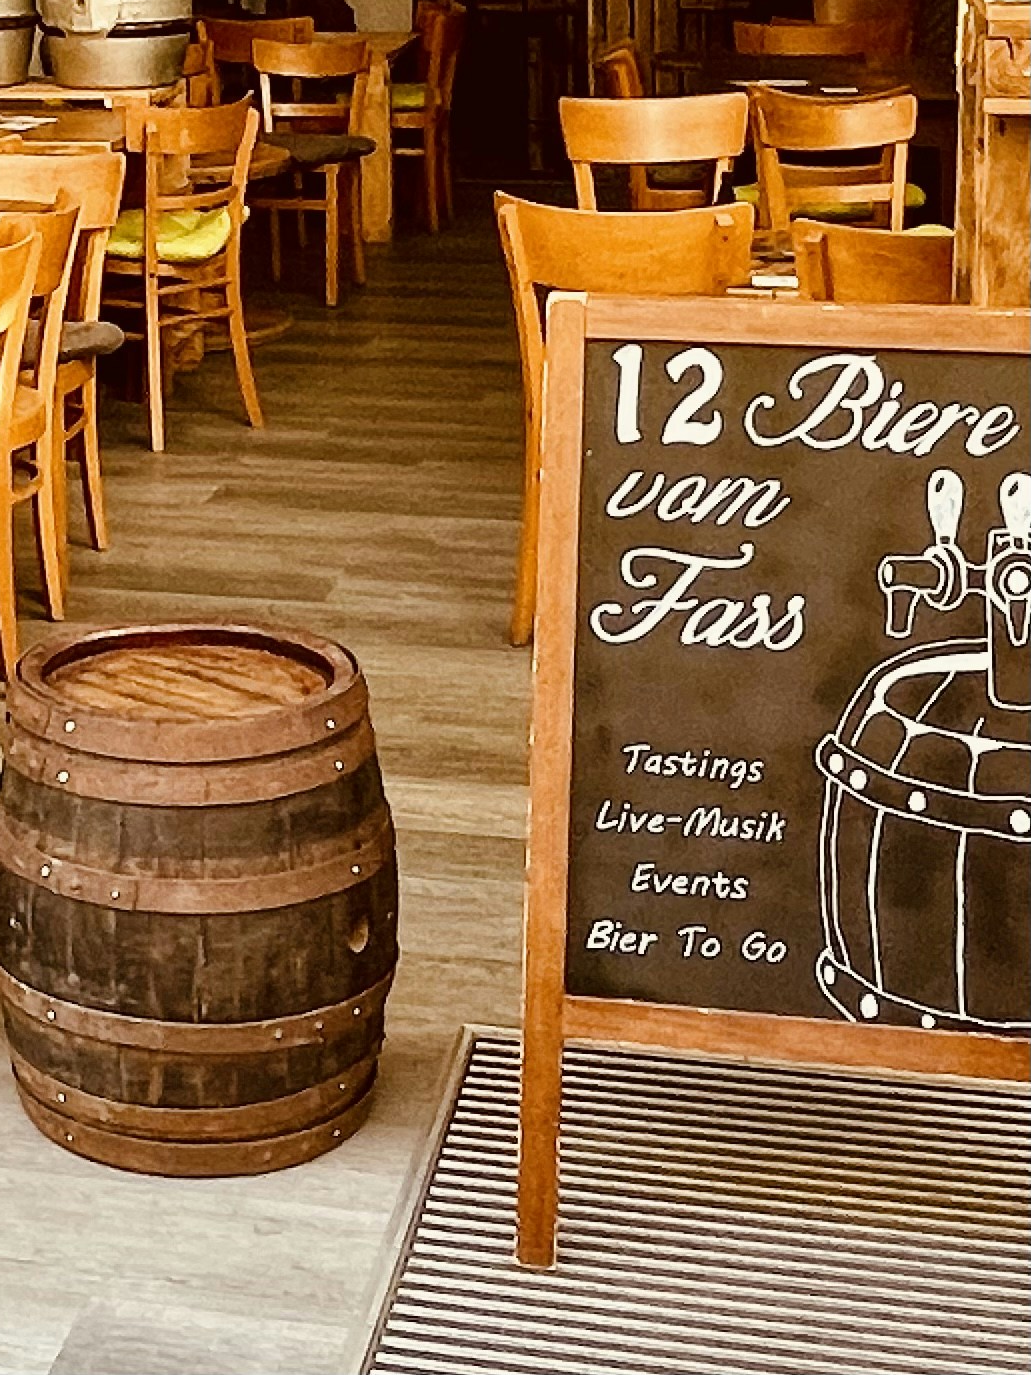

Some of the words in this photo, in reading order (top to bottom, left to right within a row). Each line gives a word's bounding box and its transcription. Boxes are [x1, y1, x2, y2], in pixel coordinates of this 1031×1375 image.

[611, 342, 725, 446] 12
[743, 353, 1021, 457] Biere
[605, 470, 792, 528] vom
[589, 541, 806, 652] Fass
[622, 743, 765, 789] Tastings
[594, 799, 787, 843] Live-Musik
[630, 862, 750, 900] Events
[585, 919, 659, 956] Bier
[676, 925, 722, 958] To
[741, 931, 789, 964] Go
